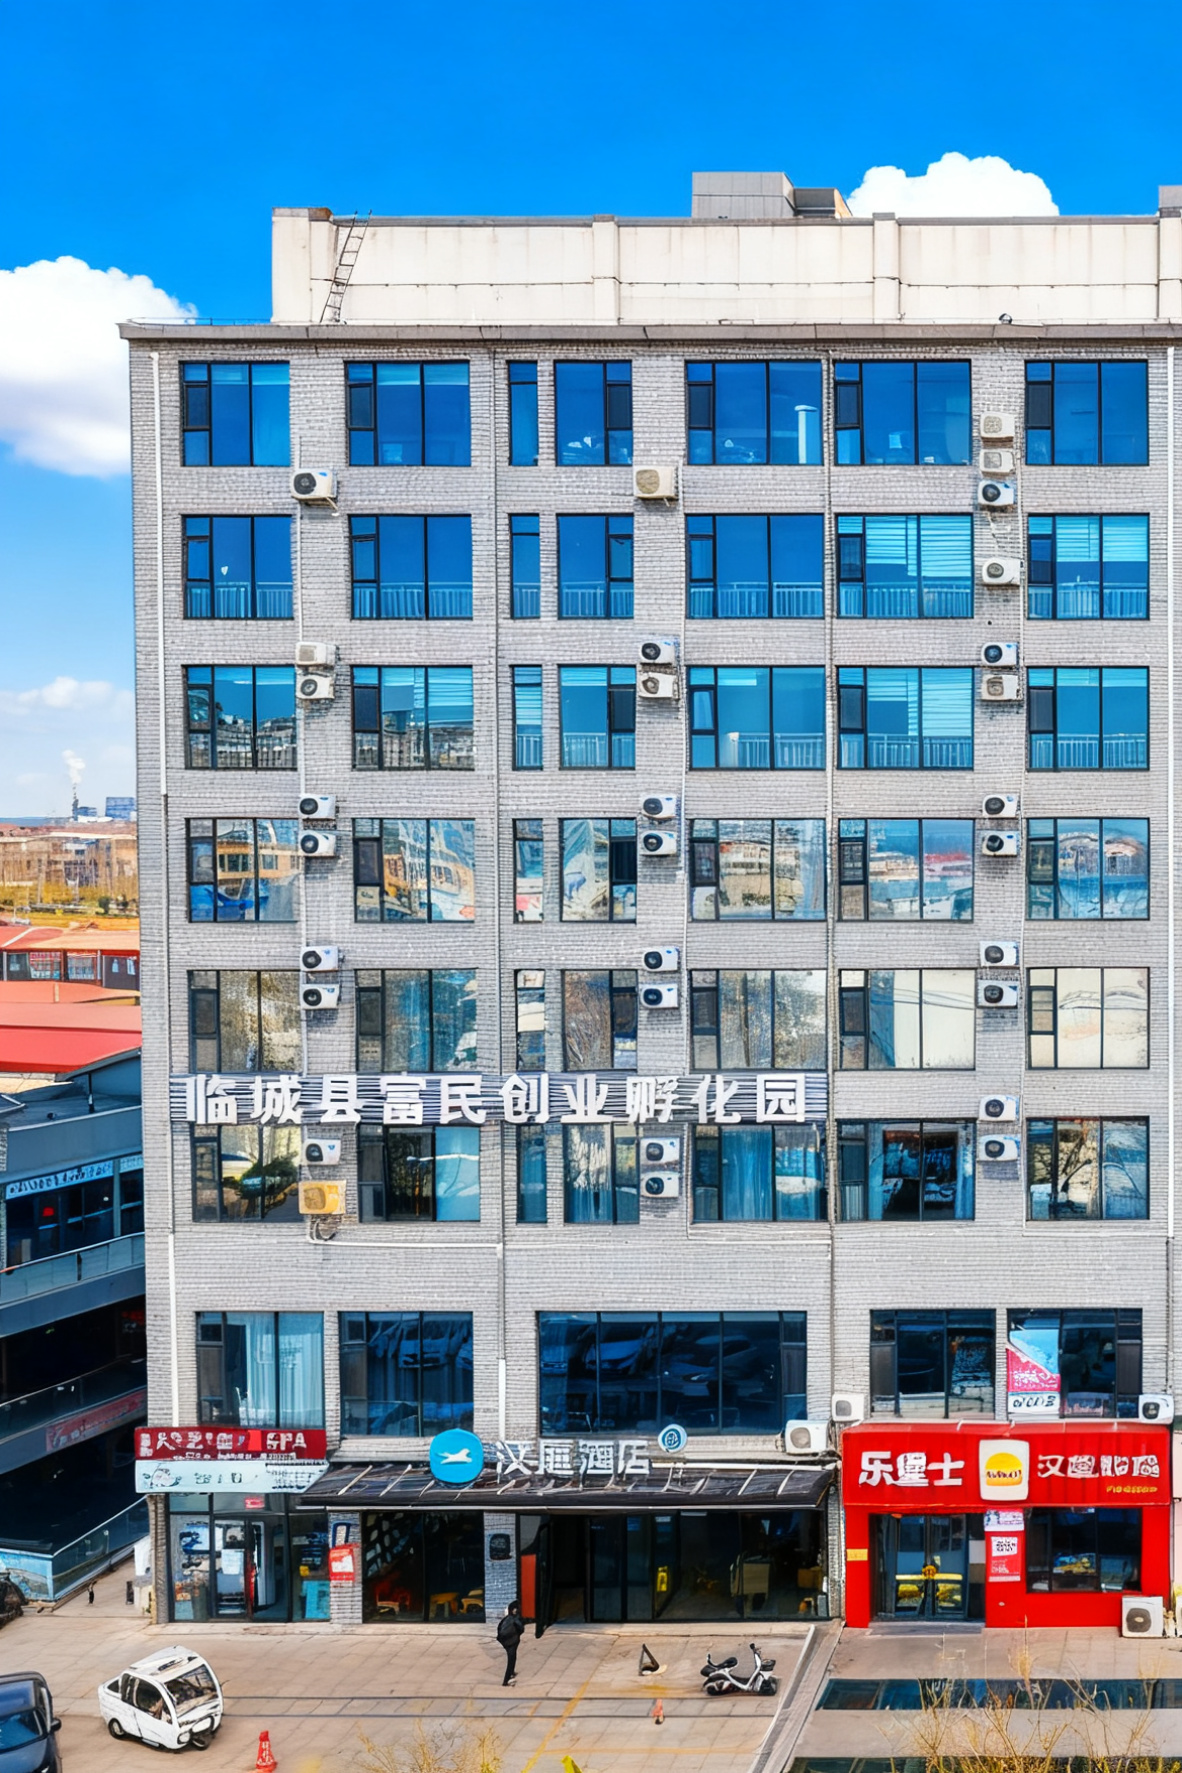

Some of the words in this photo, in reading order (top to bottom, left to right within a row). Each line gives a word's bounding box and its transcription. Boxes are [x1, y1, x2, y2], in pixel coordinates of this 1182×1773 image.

[186, 1073, 805, 1125] 临城县富民创业孵化园
